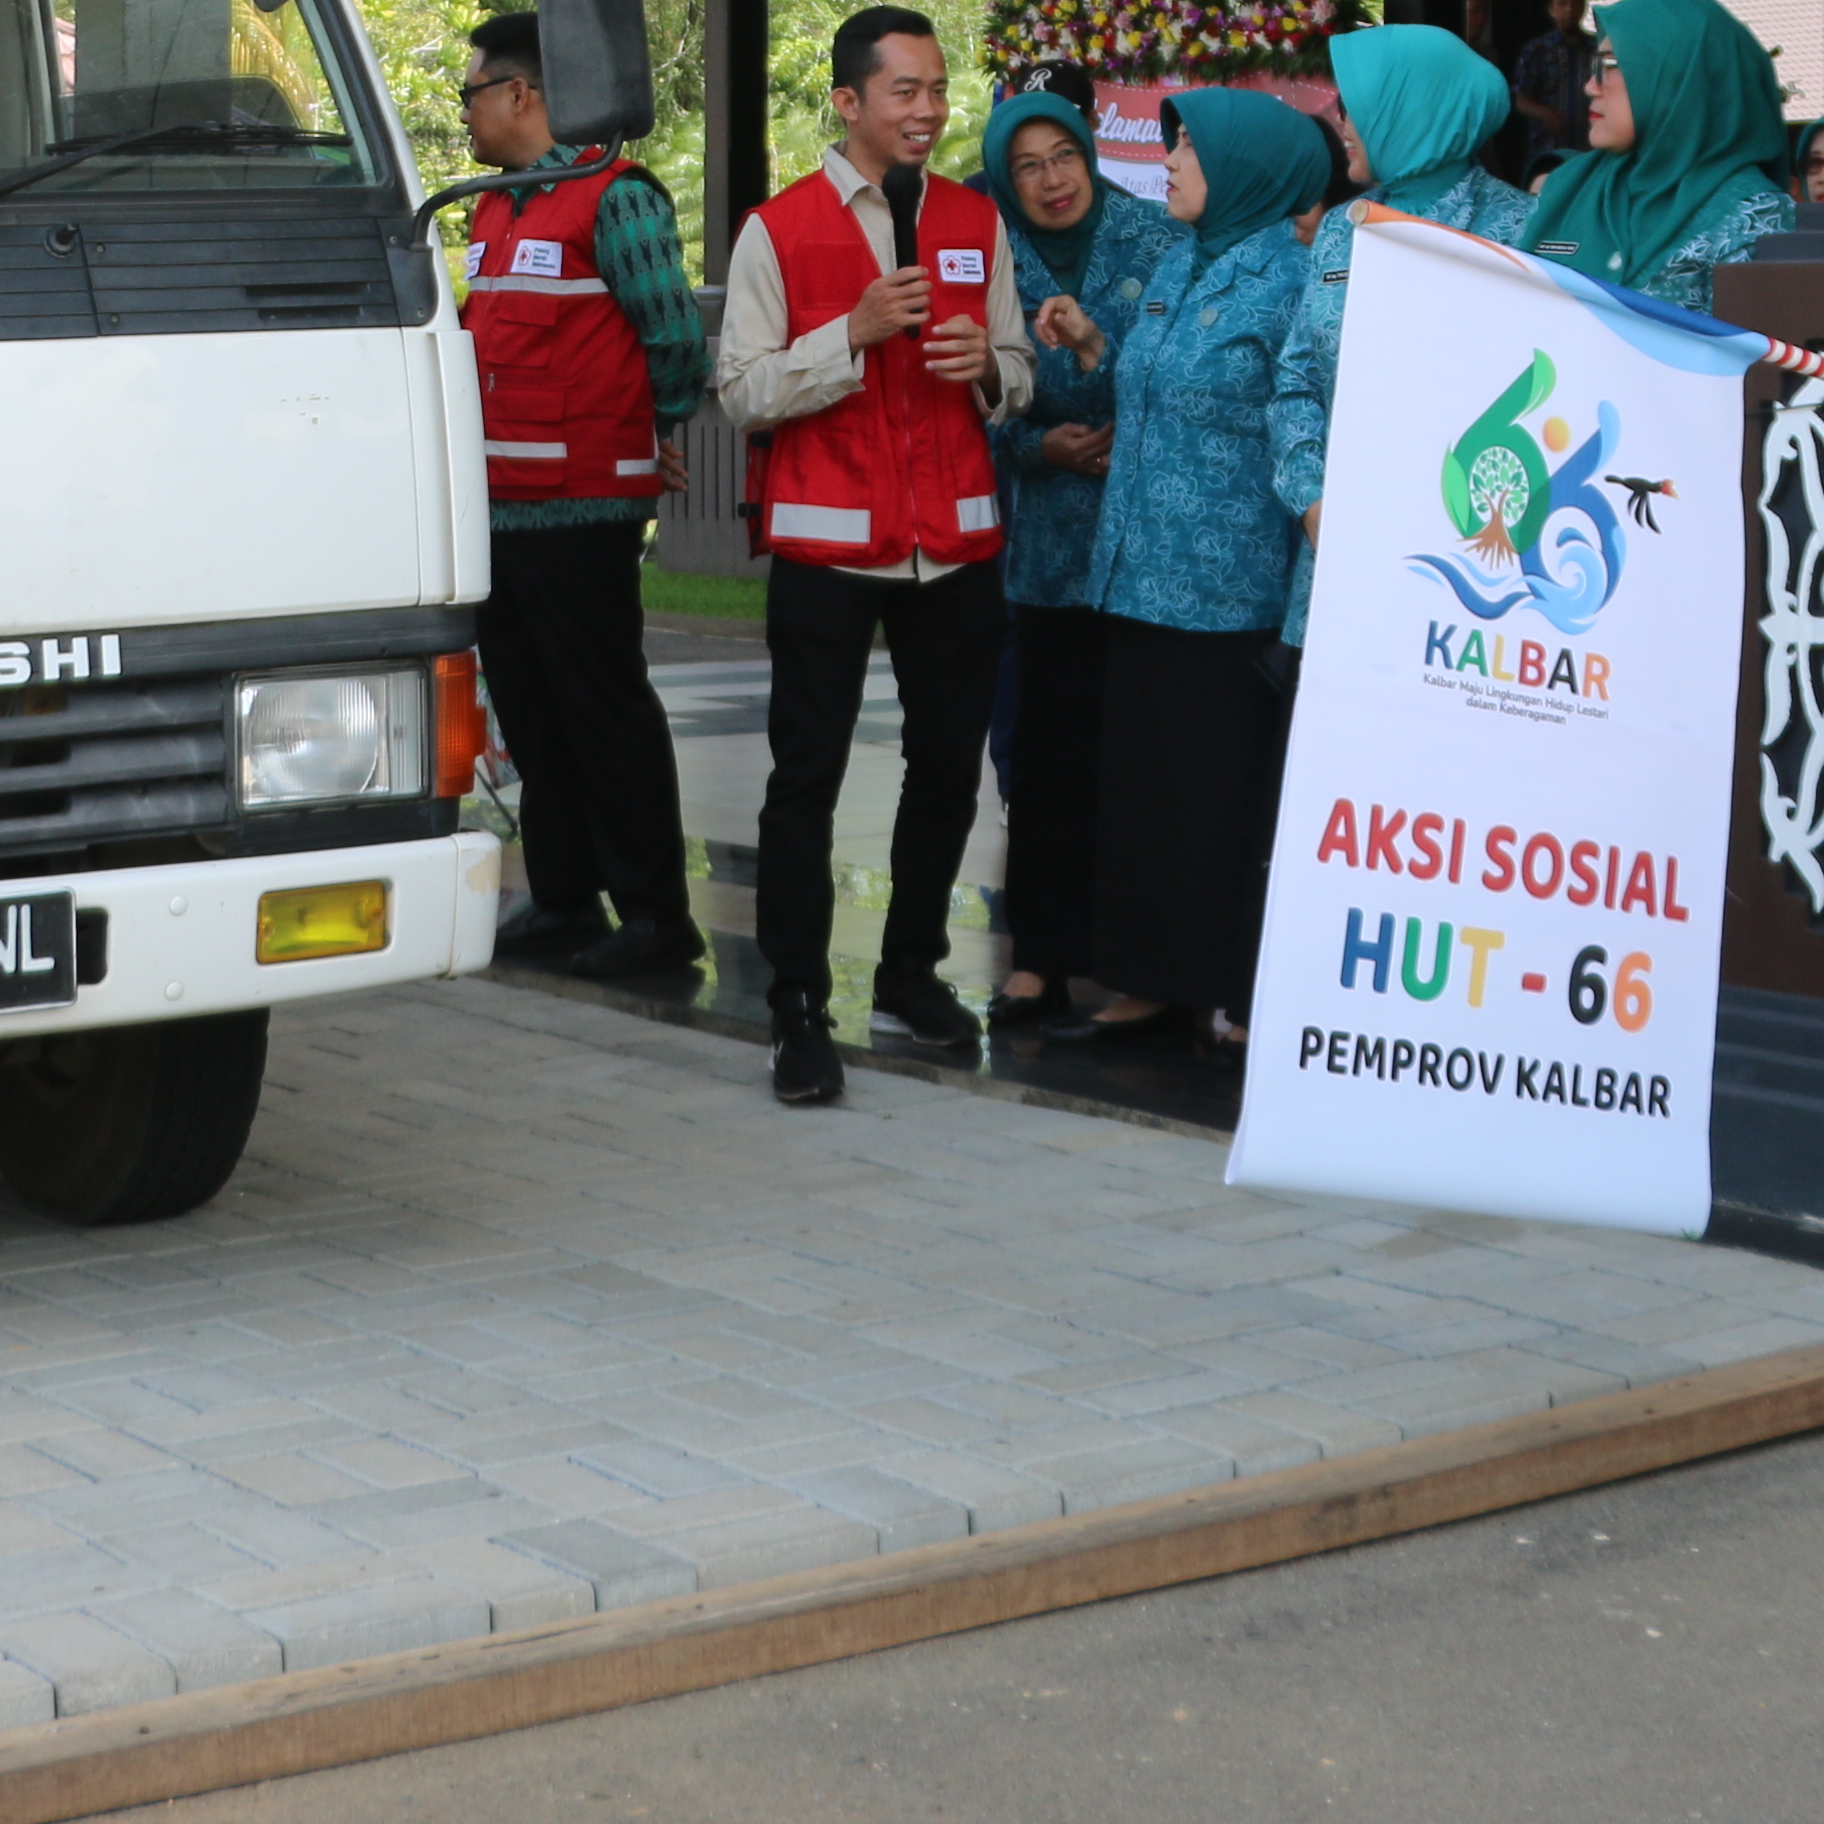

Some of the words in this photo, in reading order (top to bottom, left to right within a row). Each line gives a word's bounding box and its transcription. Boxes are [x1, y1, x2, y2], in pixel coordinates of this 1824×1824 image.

[1424, 620, 1611, 701] KALBAR
[1424, 673, 1458, 690] Kalbar
[1459, 679, 1484, 695] Maju
[1485, 687, 1543, 707] Lingkungan
[1545, 696, 1575, 715] Hidup
[1576, 703, 1610, 720] Lestari
[1466, 696, 1497, 712] dalam
[1499, 701, 1567, 725] Keberagaman
[1316, 797, 1466, 885] AKSI
[1481, 824, 1690, 923] SOSIAL
[1339, 906, 1505, 1009] HUT
[1568, 944, 1654, 1034] 66
[1299, 1025, 1506, 1096] PEMPROV
[1515, 1055, 1672, 1119] KALBAR
